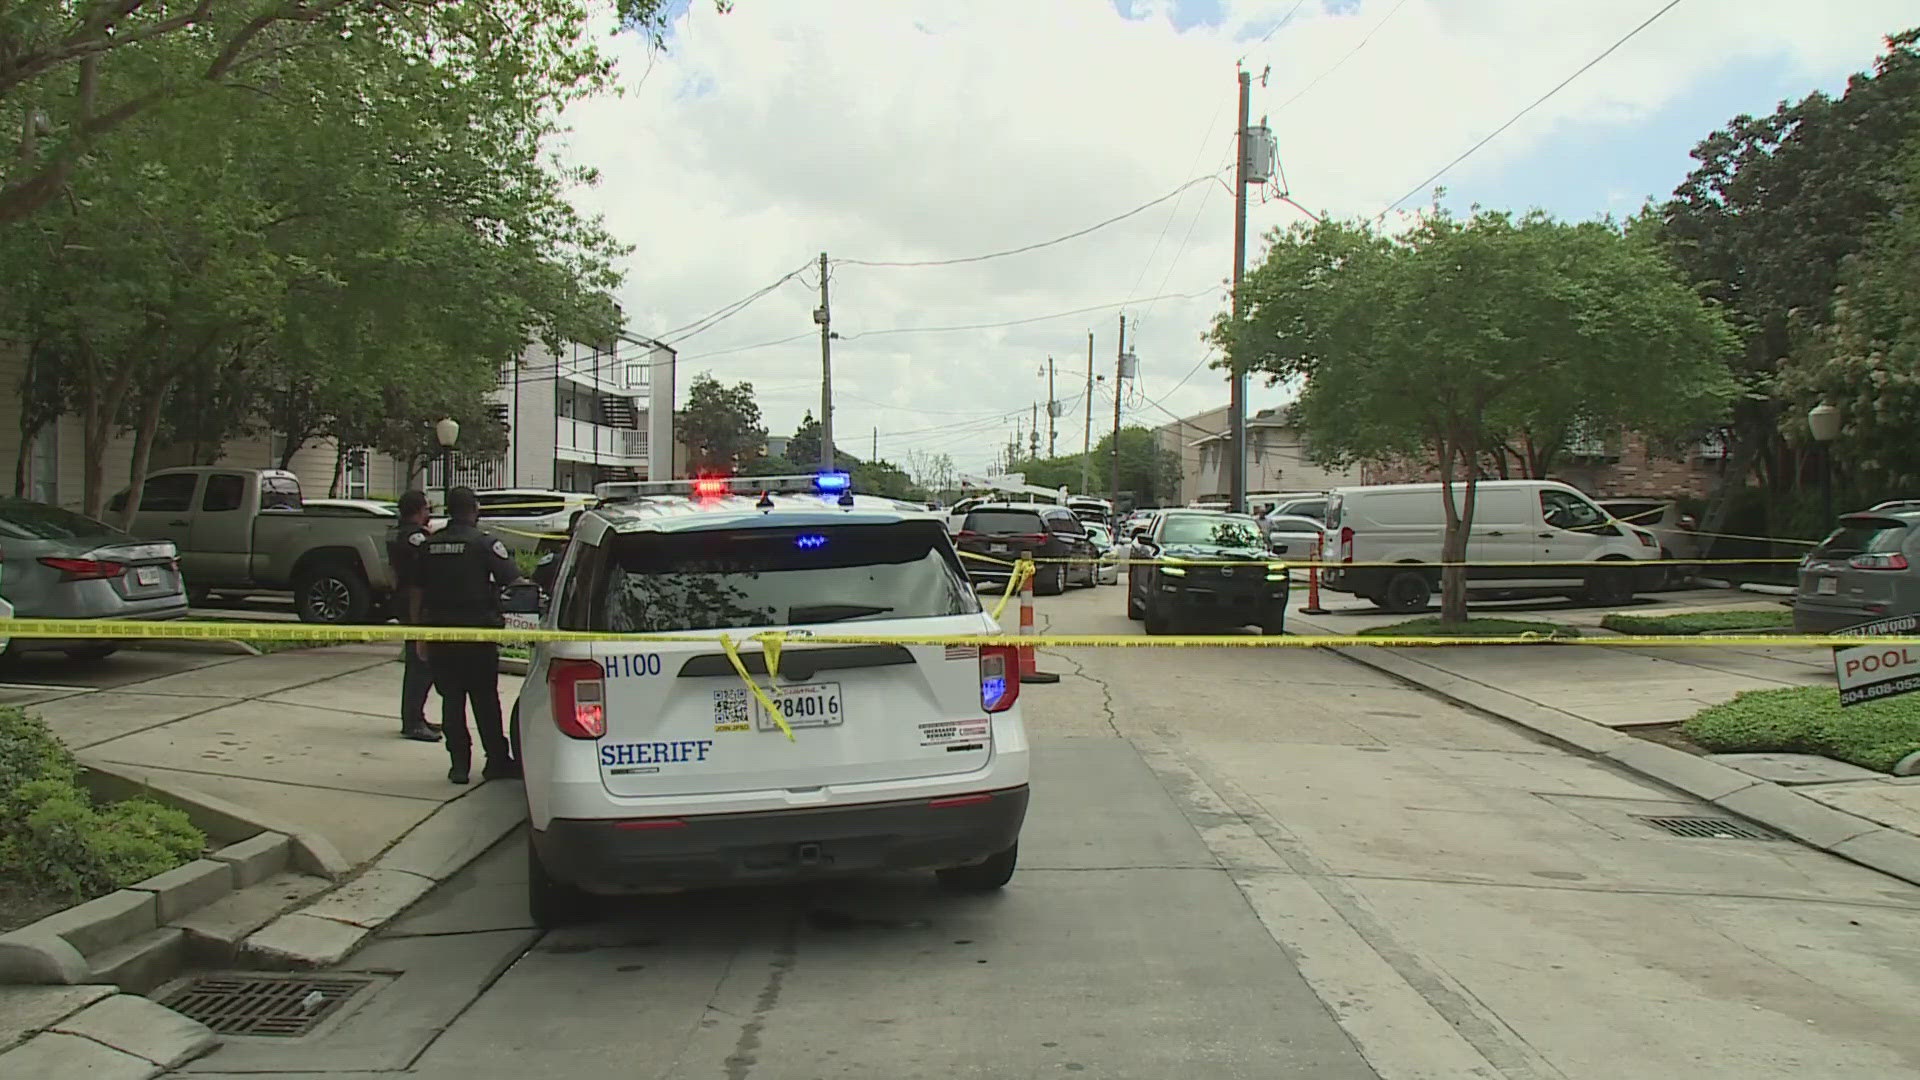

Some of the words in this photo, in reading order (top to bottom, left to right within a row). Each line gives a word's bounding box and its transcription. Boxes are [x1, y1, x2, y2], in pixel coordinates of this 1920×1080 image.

[430, 543, 466, 554] SHERIFF
[605, 653, 661, 678] H100
[1846, 649, 1917, 678] POOL
[601, 740, 713, 766] SHERIFF
